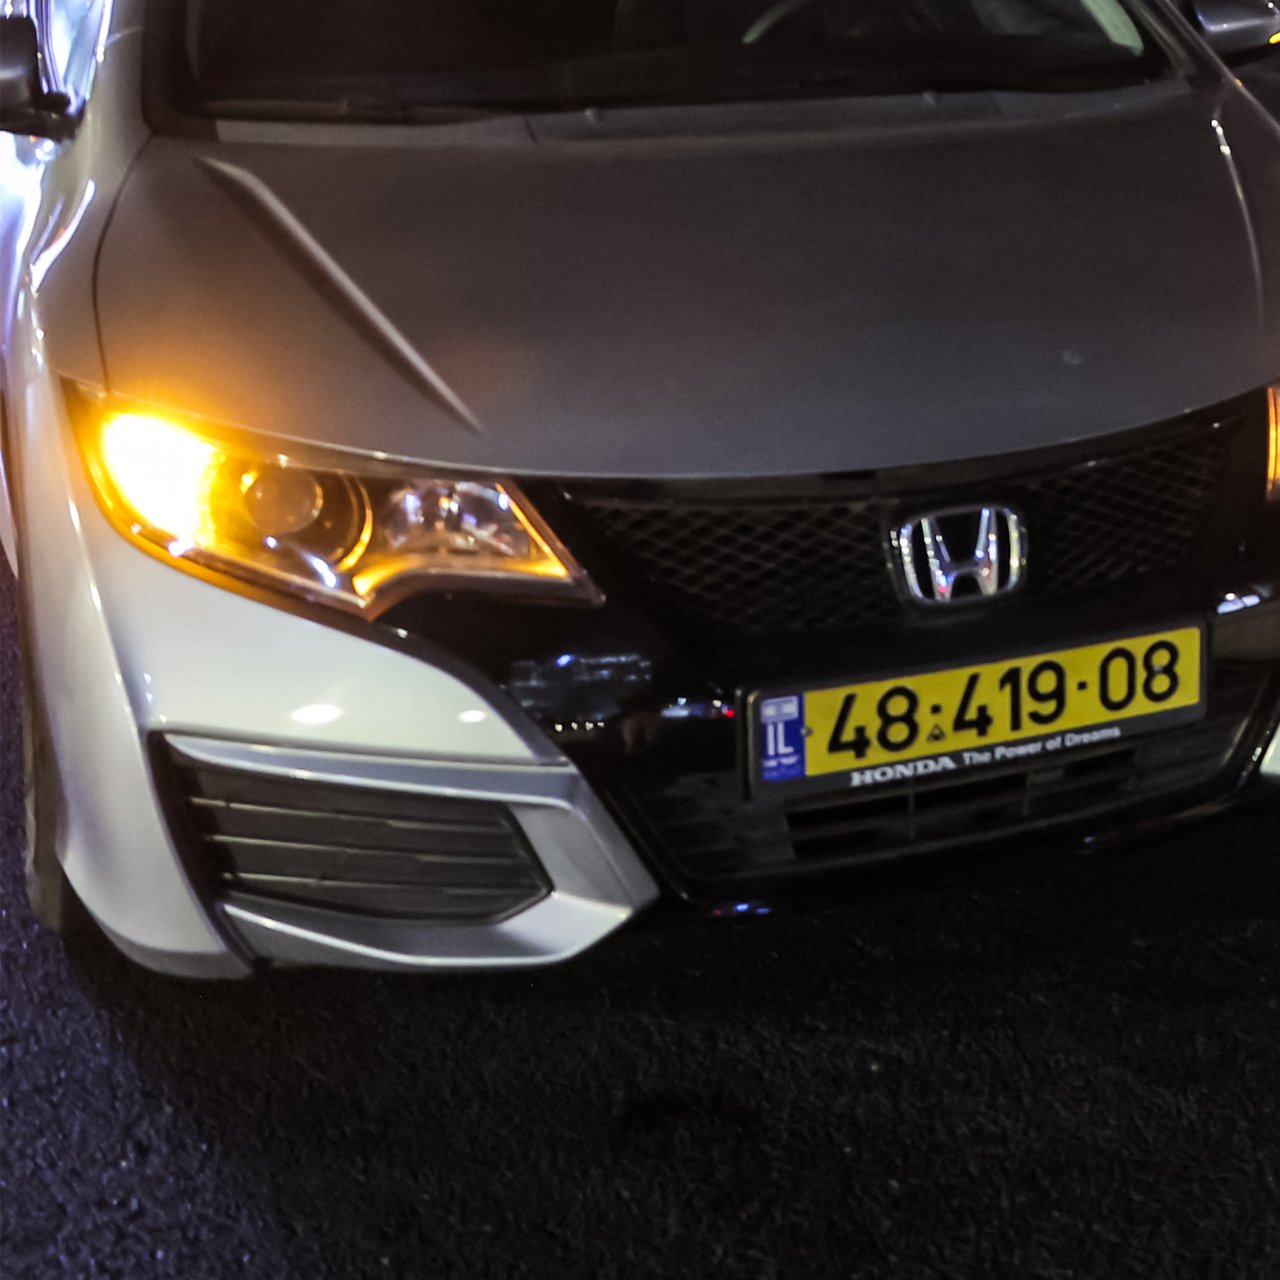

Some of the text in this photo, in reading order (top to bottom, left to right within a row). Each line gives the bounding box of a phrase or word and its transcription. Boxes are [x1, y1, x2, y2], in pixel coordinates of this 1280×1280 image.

[766, 722, 795, 757] IL
[850, 726, 1122, 787] HONDA The Power of Dreams
